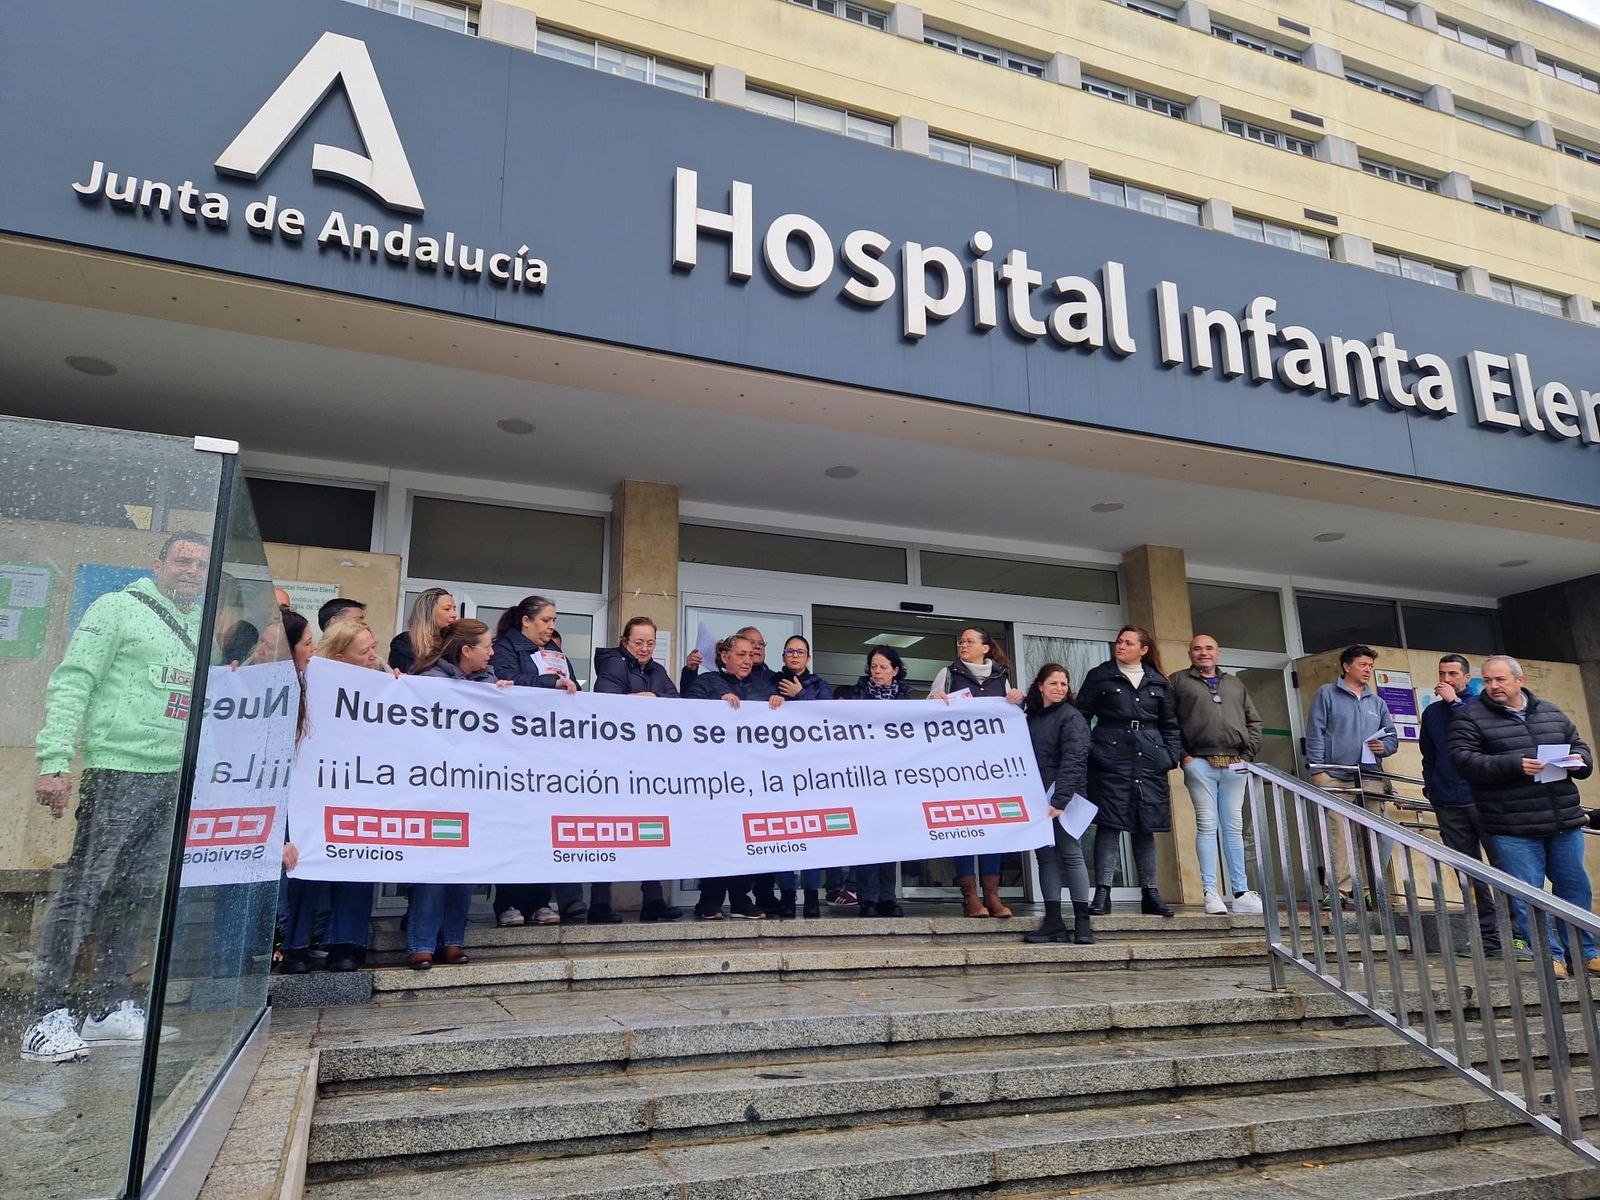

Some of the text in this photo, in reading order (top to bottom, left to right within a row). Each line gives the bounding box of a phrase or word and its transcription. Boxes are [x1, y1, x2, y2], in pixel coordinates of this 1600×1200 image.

[71, 160, 548, 290] Junta de Andalucía
[673, 166, 1137, 357] Hospital
[1155, 280, 1459, 417] Infanta
[334, 687, 1006, 749] Nuestros salarios no se negocian: se pagan
[317, 755, 1028, 800] ¡¡¡La administración incumple, la plantilla responde!!!
[928, 803, 997, 824] CCOO
[331, 813, 426, 840] CCOO
[557, 821, 634, 842] CCOO
[748, 814, 822, 837] CCOO
[929, 828, 986, 841] Servicios
[325, 844, 404, 861] Servicios
[553, 849, 617, 863] Servicios
[746, 841, 808, 857] Servicios
